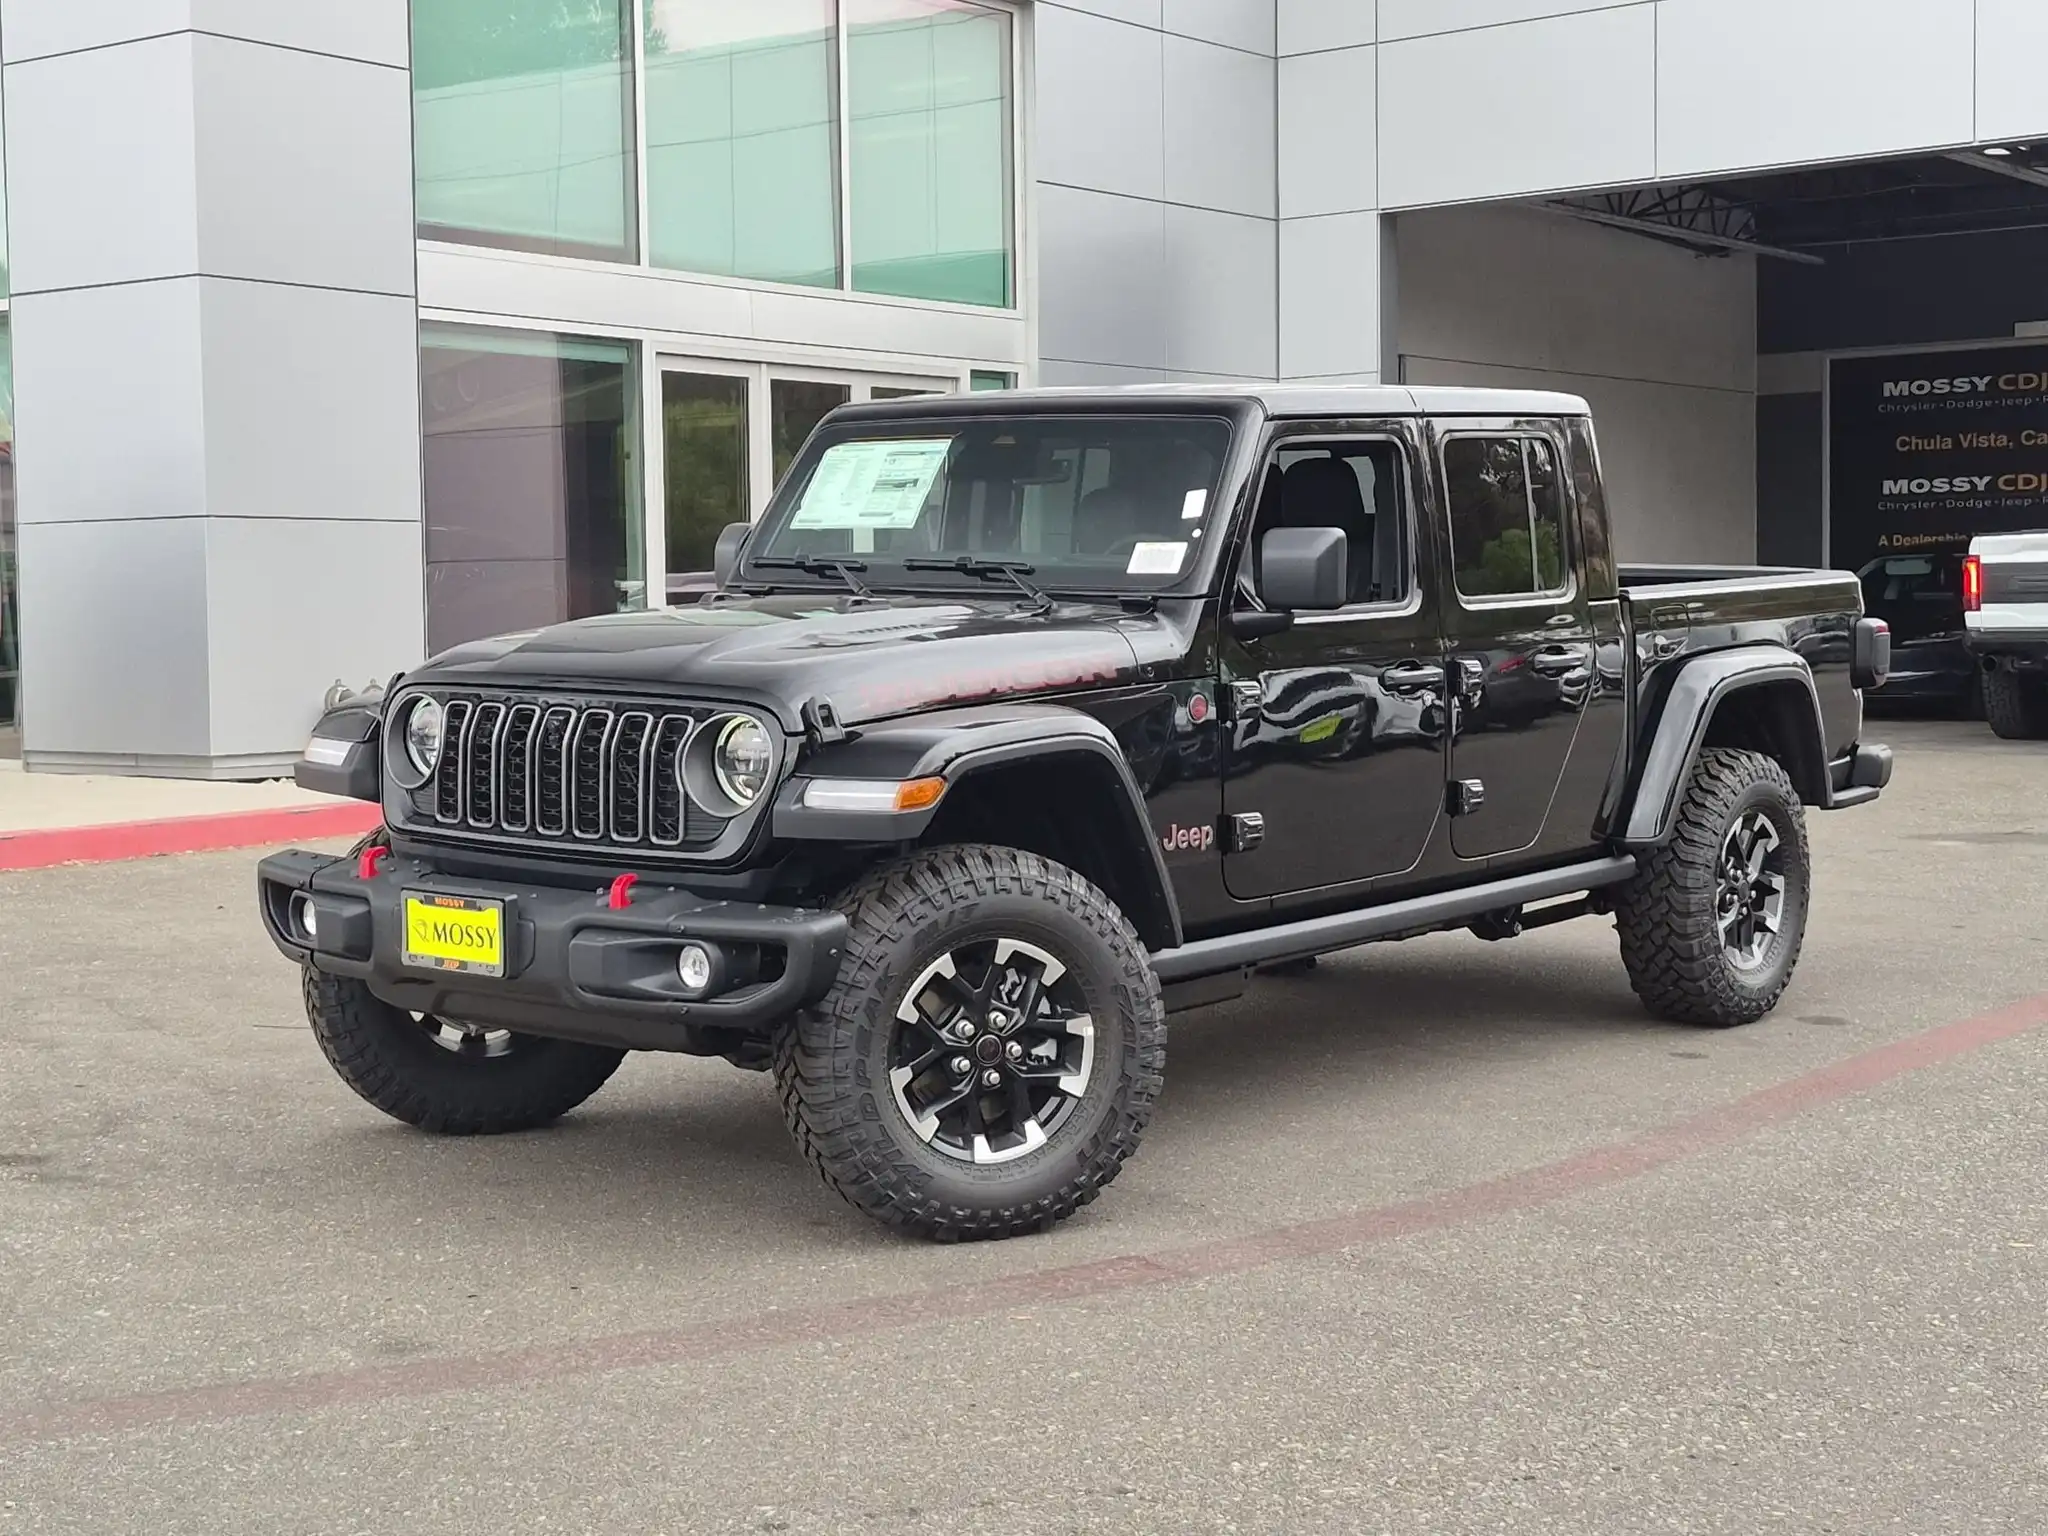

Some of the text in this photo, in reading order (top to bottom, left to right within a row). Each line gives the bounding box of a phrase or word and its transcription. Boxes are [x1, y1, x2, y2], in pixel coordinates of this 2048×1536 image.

[1882, 372, 2048, 397] MOSSY CDJ
[1878, 401, 1936, 413] Chrysler
[1946, 399, 1993, 410] Dodge
[2002, 396, 2032, 407] Jeep
[1896, 429, 2048, 452] Chula Vista, Ca
[1881, 473, 2048, 496] MOSSY CDJ
[1878, 501, 1936, 512] Chrysler
[1946, 498, 1993, 509] Dodge
[2001, 496, 2033, 507] Jeep
[1878, 536, 1889, 547] A
[1163, 823, 1214, 851] Jeep
[434, 896, 465, 908] MOSSY
[433, 921, 497, 949] MOSSY
